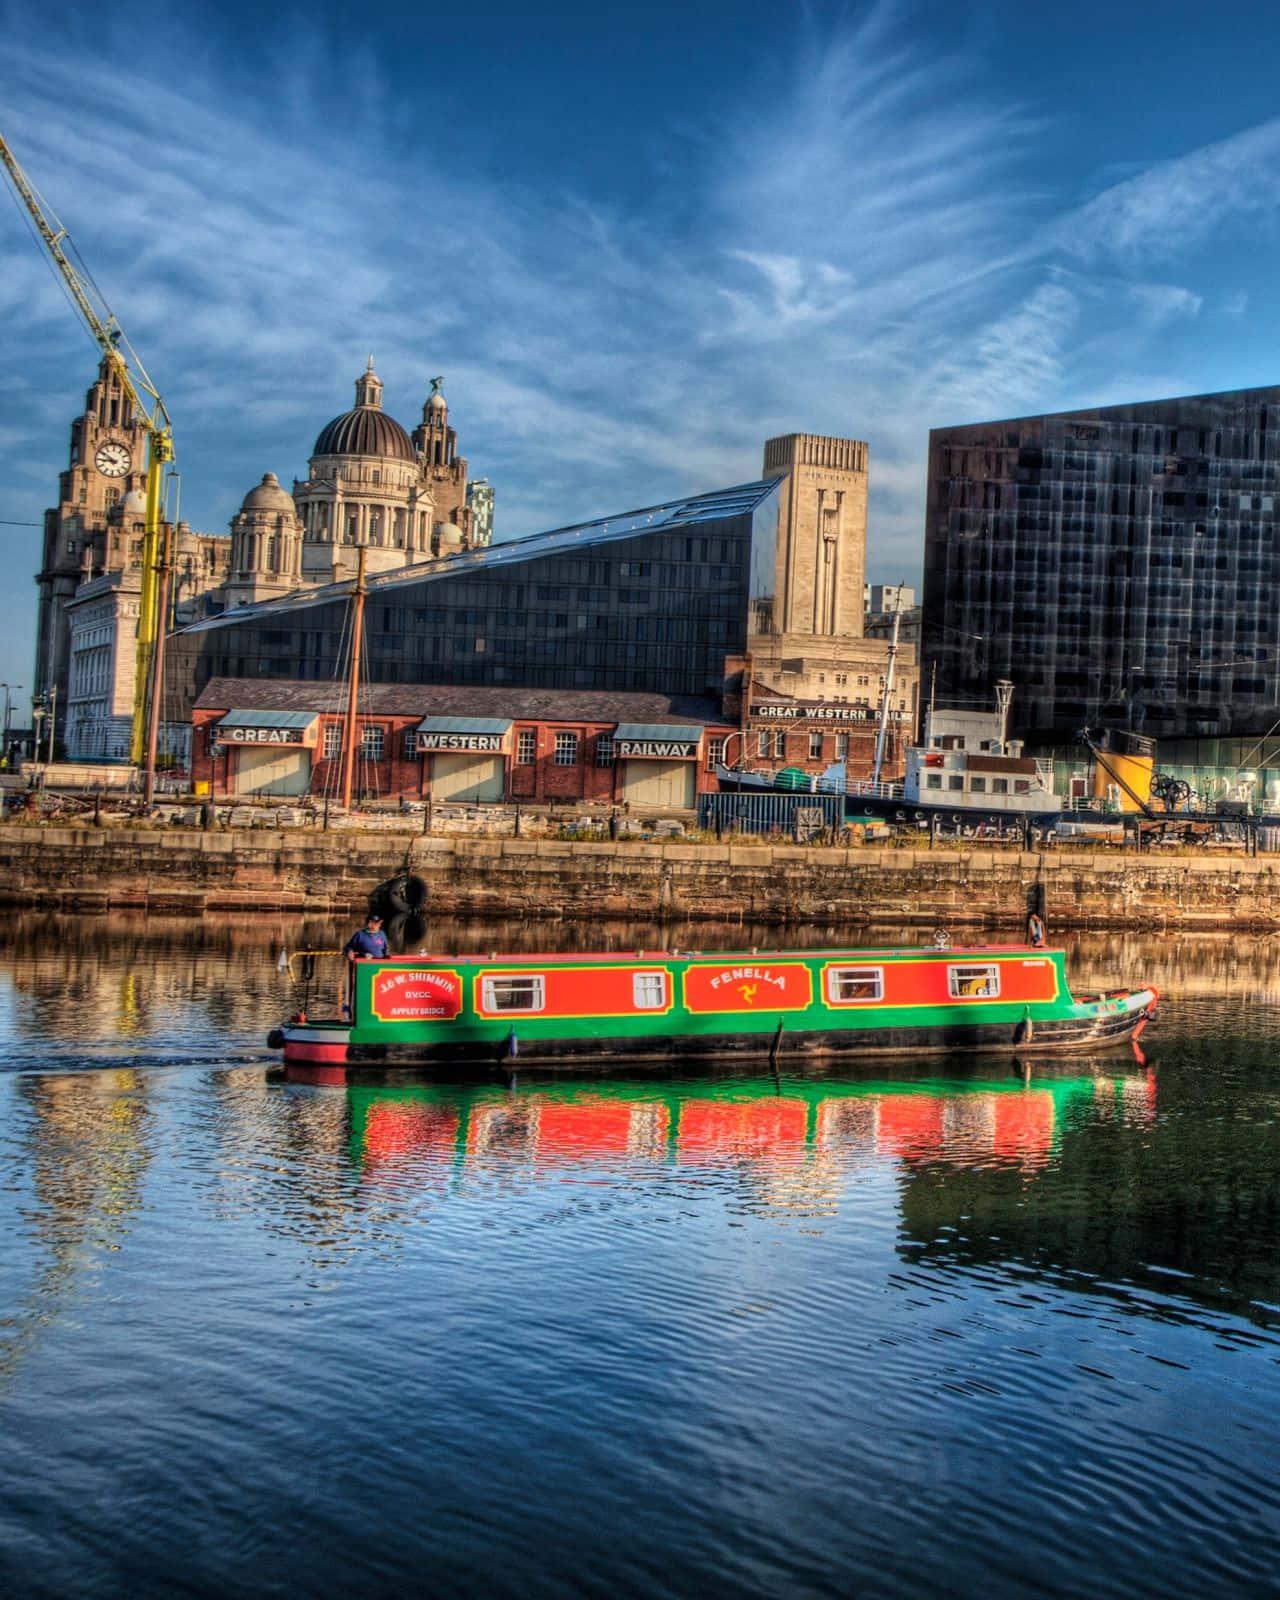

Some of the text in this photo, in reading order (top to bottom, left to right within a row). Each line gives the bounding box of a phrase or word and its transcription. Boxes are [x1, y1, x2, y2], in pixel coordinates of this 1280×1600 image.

[759, 706, 798, 717] GREAT
[806, 709, 866, 720] WESTERN
[232, 729, 290, 742] GREAT
[423, 735, 500, 750] WESTERN
[621, 742, 690, 756] RAILWAY
[409, 972, 456, 993] SHIMMIN
[710, 968, 785, 990] FENELLA
